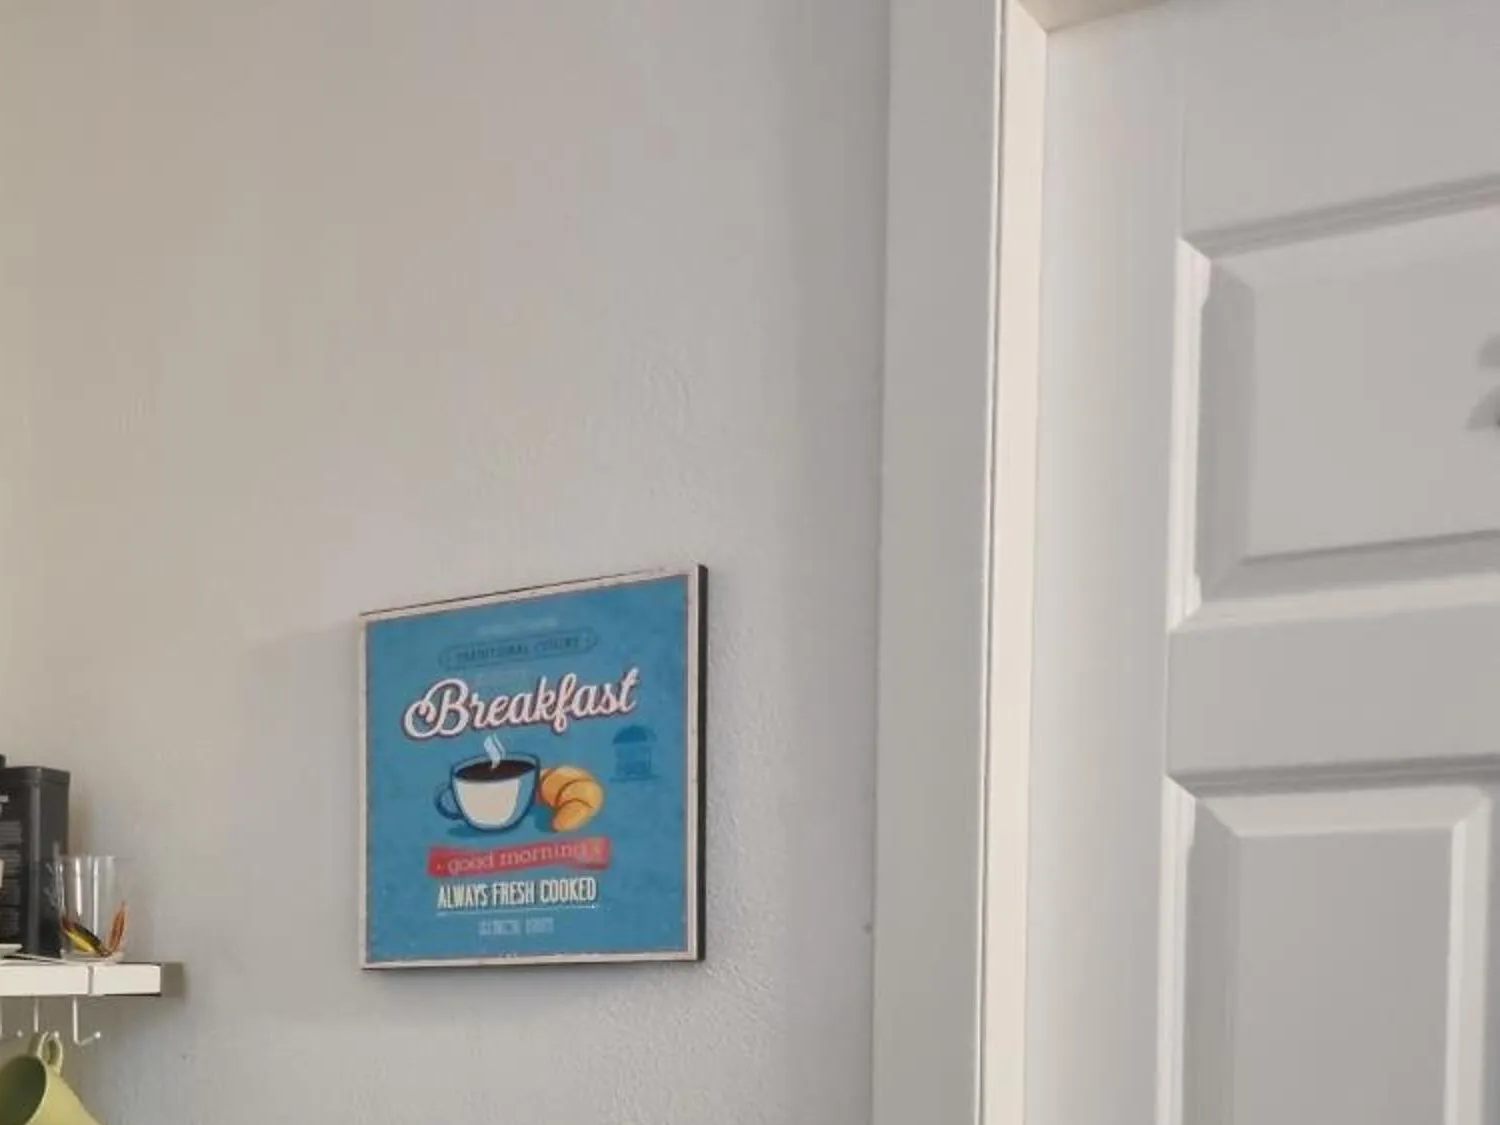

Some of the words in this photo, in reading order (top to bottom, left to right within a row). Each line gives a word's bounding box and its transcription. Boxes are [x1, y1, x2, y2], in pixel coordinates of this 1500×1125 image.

[403, 666, 639, 738] Breakfast
[448, 851, 494, 875] good
[437, 883, 488, 909] ALWAYS
[493, 880, 534, 905] FRESH
[539, 875, 597, 903] COOKED
